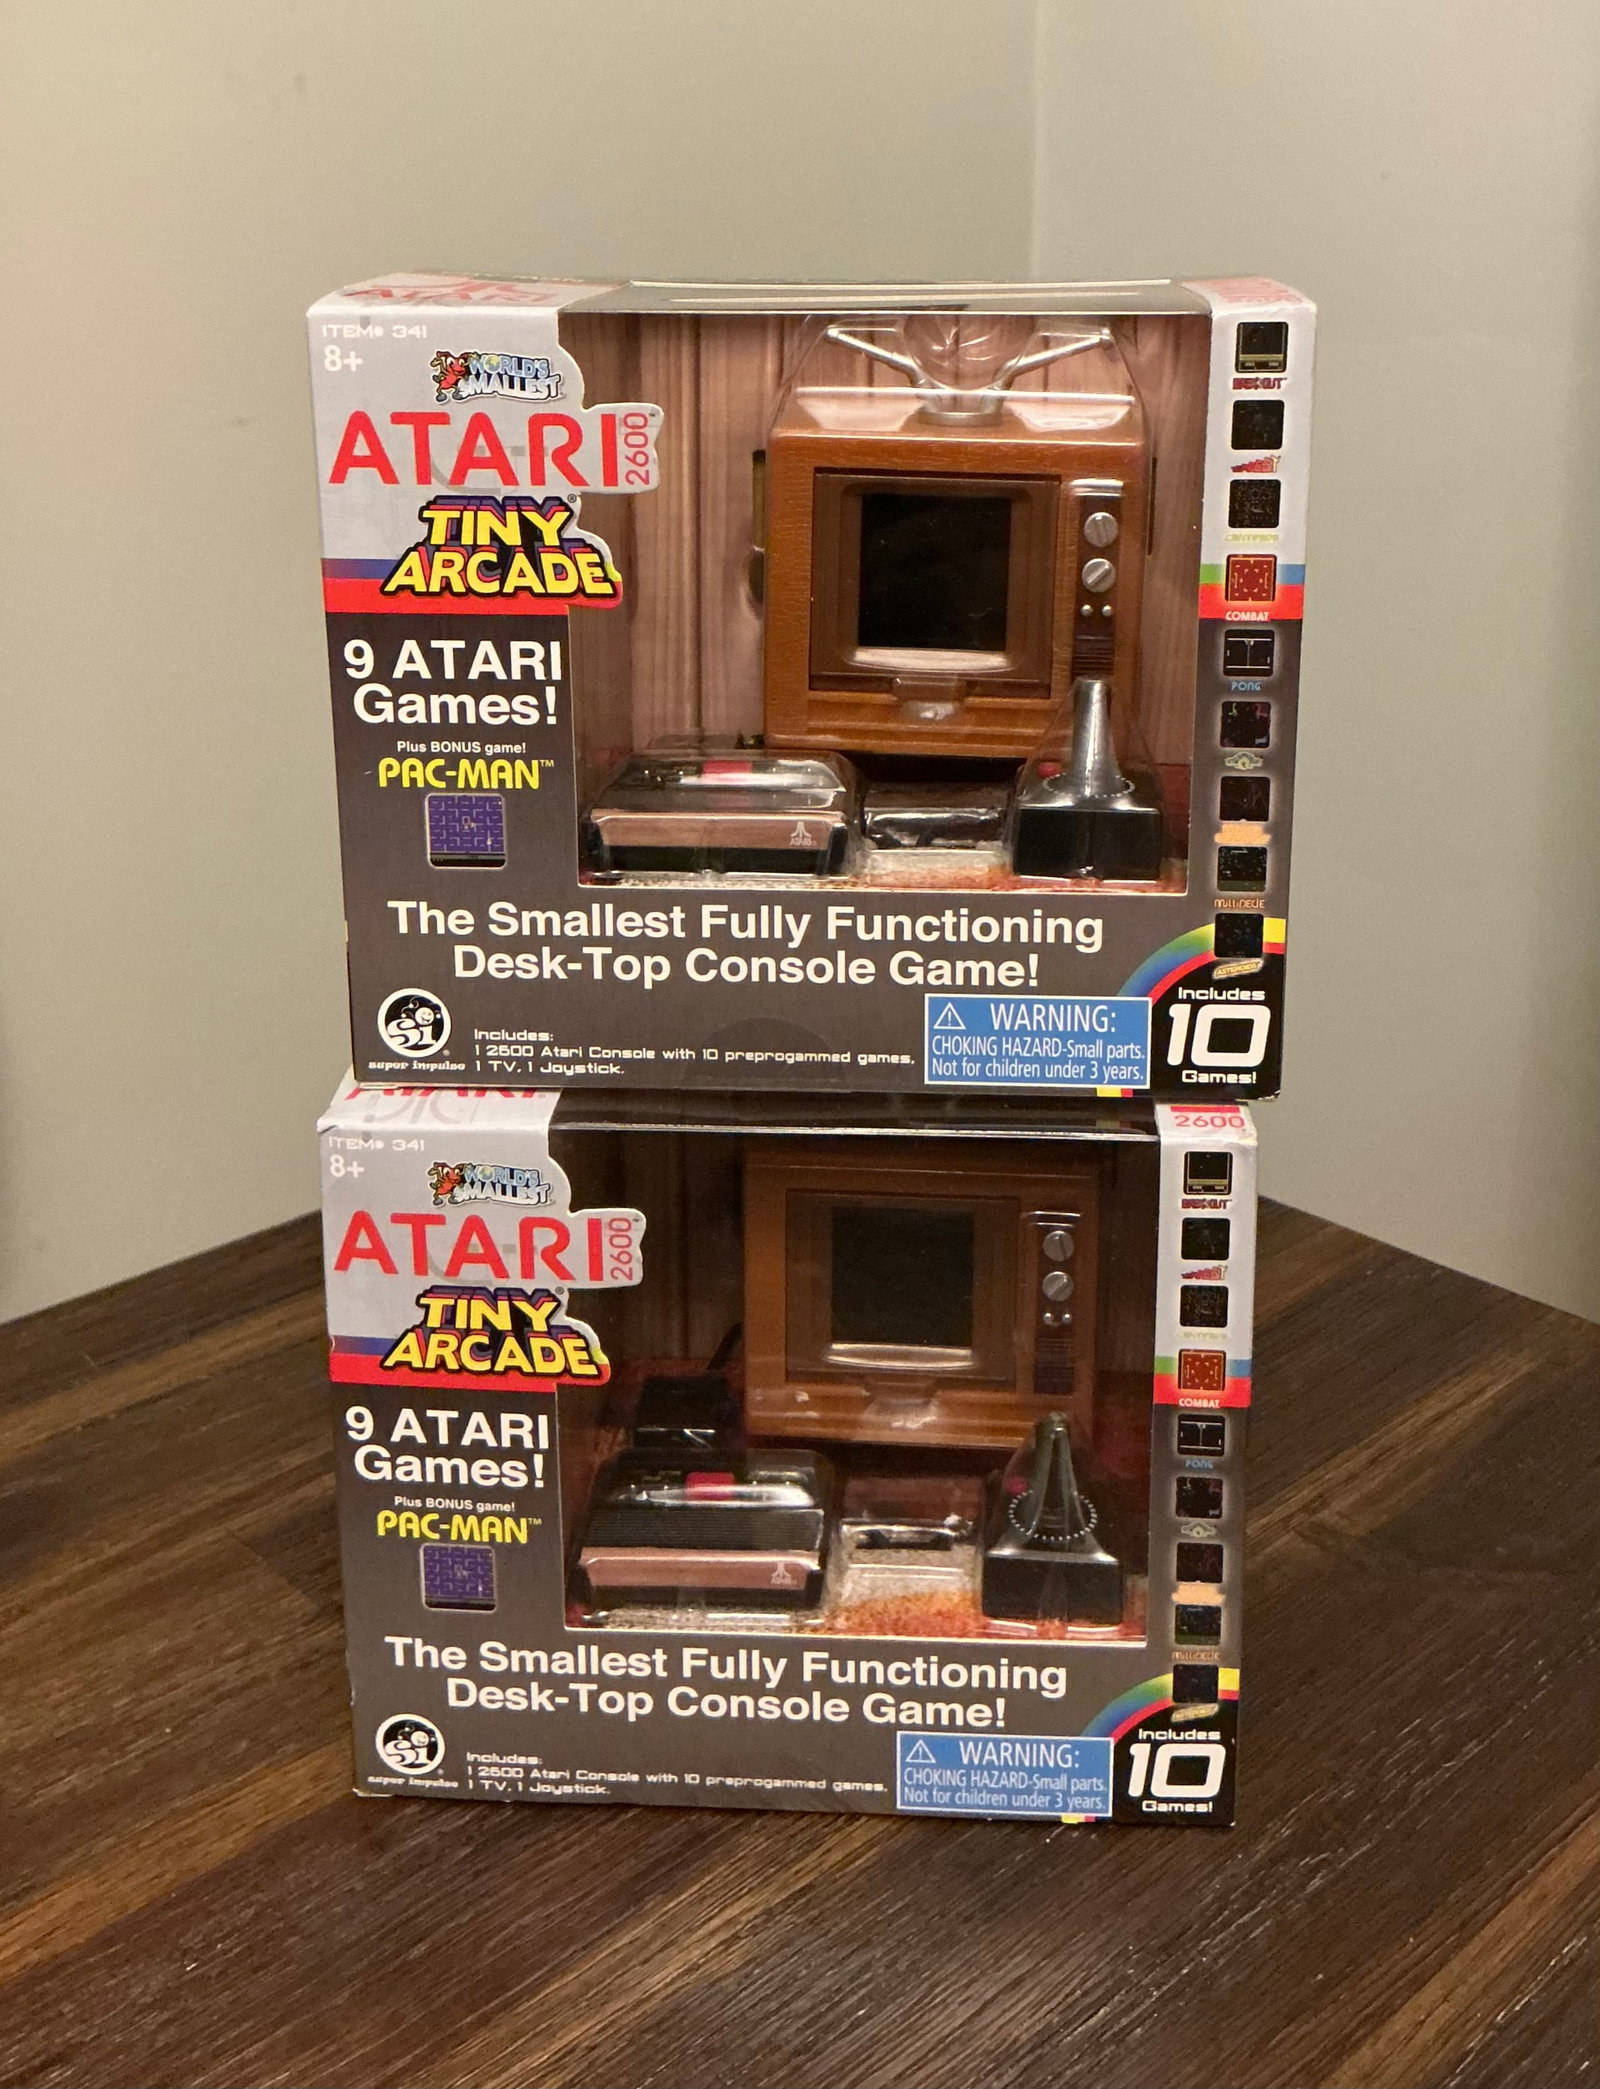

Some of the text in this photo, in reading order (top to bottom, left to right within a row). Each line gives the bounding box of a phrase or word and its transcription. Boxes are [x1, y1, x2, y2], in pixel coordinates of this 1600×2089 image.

[322, 324, 427, 339] ITEM# 341
[324, 345, 363, 372] 8+
[468, 353, 549, 377] WORLD'S
[458, 374, 561, 399] SMALLEST
[328, 410, 619, 487] ATARI
[623, 412, 649, 485] 2600
[422, 508, 571, 546] TINY
[383, 552, 614, 594] ARCADE
[1225, 611, 1270, 621] COMBAT
[344, 640, 562, 681] 9 ATARI
[1231, 682, 1261, 691] PONG
[354, 683, 557, 725] Games!
[397, 741, 526, 756] Plus BONUS game!
[387, 901, 1103, 953] The Smallest Fully Functioning
[454, 945, 1039, 989] Desk-Top Console Game!
[1178, 987, 1265, 1000] Includes
[991, 1004, 1116, 1033] WARNING:
[474, 1029, 554, 1042] Includes:
[1167, 1004, 1271, 1067] 10
[475, 1045, 480, 1056] 1
[486, 1045, 533, 1057] 2600
[540, 1046, 582, 1058] Atari
[589, 1047, 655, 1060] Console
[662, 1048, 695, 1060] with
[703, 1049, 718, 1060] 10
[932, 1036, 1146, 1063] CHOKING HAZARD-Small parts.
[368, 1060, 466, 1072] super impulse
[475, 1061, 480, 1072] 1
[528, 1061, 533, 1072] 1
[932, 1061, 1144, 1084] Not for children under 3 years.
[1182, 1070, 1257, 1084] Games!
[1174, 1115, 1245, 1128] 2600
[392, 1139, 425, 1152] 341
[329, 1155, 364, 1178] 8+
[463, 1164, 539, 1186] WORLD'S
[455, 1180, 549, 1204] SMALLEST
[334, 1210, 604, 1282] ATARI
[609, 1217, 633, 1281] 2600
[420, 1297, 559, 1331] TINY
[383, 1331, 599, 1375] ARCADE
[1178, 1398, 1221, 1408] COMBAT
[345, 1406, 549, 1449] 9 ATARI
[354, 1445, 544, 1488] Games!
[394, 1496, 515, 1512] Plus BONUS game!
[384, 1636, 1067, 1698] The Smallest Fully Functioning
[447, 1677, 1006, 1727] Desk-Top Console Game!
[1139, 1729, 1221, 1740] Includes
[466, 1752, 543, 1765] Includes:
[959, 1740, 1080, 1768] WARNING:
[530, 1769, 570, 1780] Atari
[575, 1770, 640, 1782] Console
[645, 1773, 678, 1784] with
[684, 1773, 701, 1785] 10
[904, 1768, 967, 1788] CHOKING
[1070, 1775, 1107, 1793] parts.
[1128, 1743, 1226, 1797] 10
[904, 1787, 1106, 1812] Not for children under 3 years.
[1142, 1800, 1213, 1813] Games!
